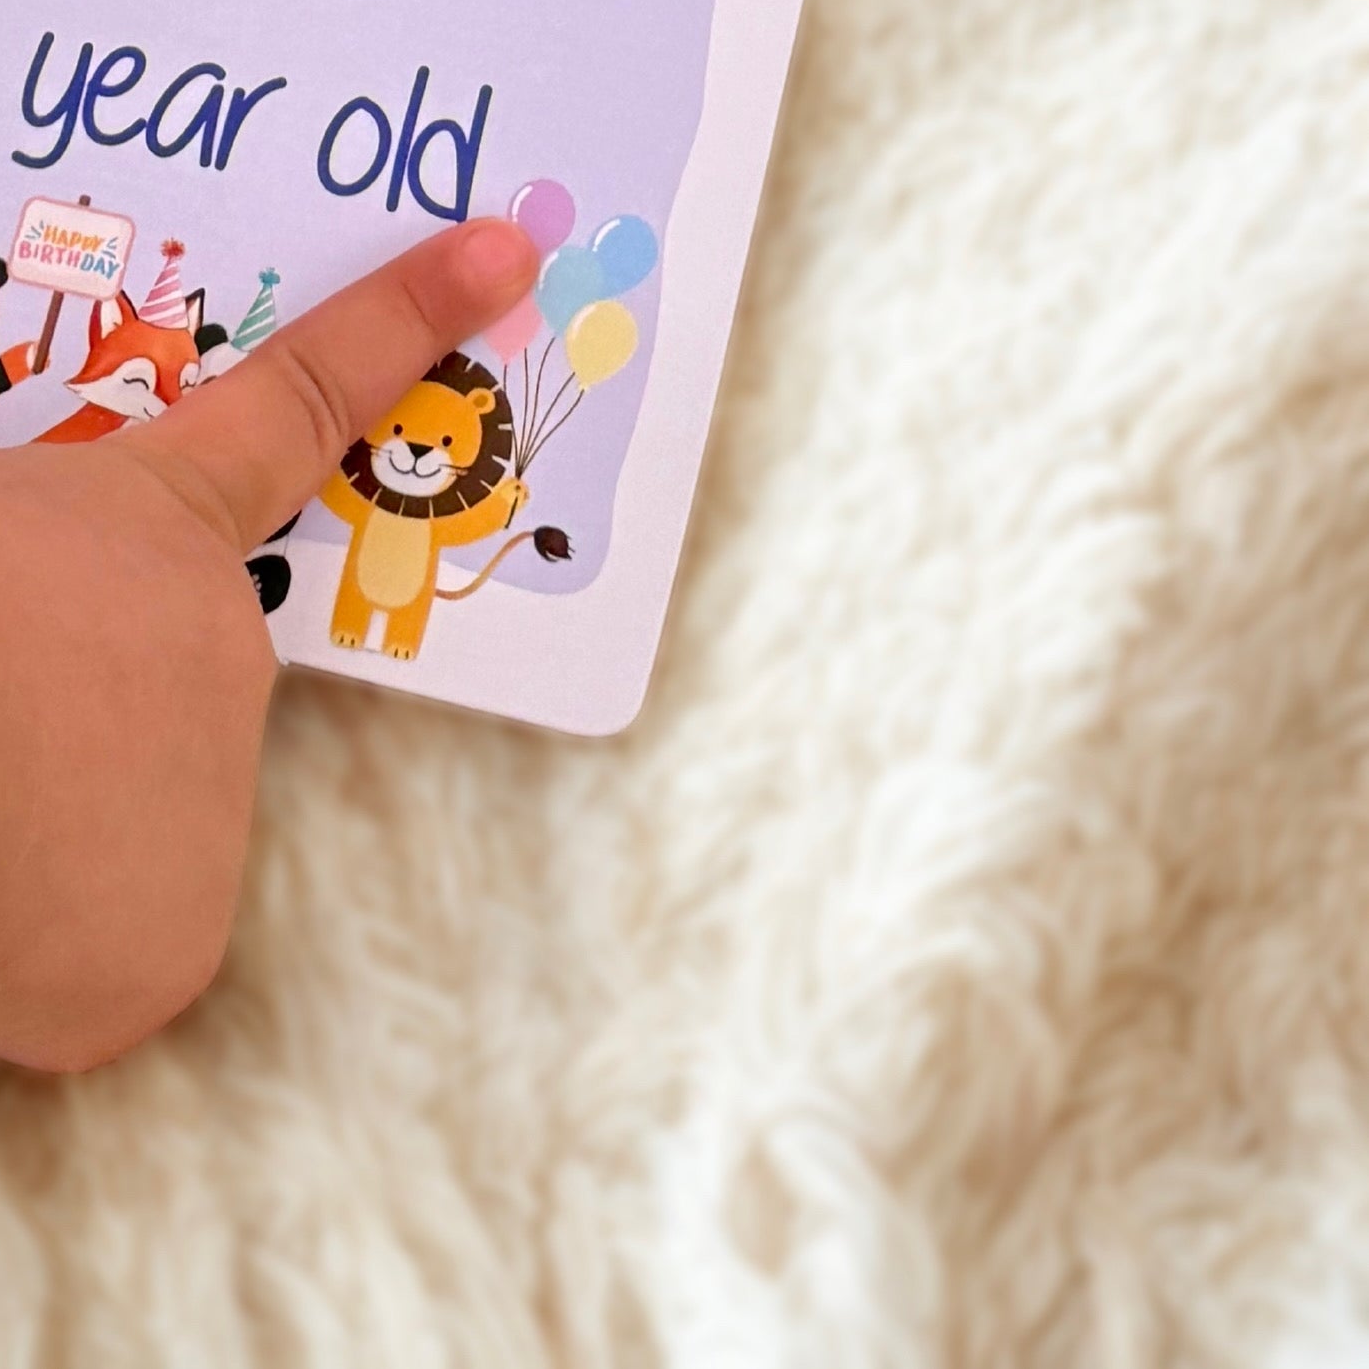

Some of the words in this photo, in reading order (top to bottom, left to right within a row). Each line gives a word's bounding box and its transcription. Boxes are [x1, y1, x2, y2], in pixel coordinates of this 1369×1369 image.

[11, 31, 288, 172] year
[316, 65, 493, 224] old
[43, 224, 104, 253] HAPPY
[18, 240, 120, 280] BIRTHDAY
